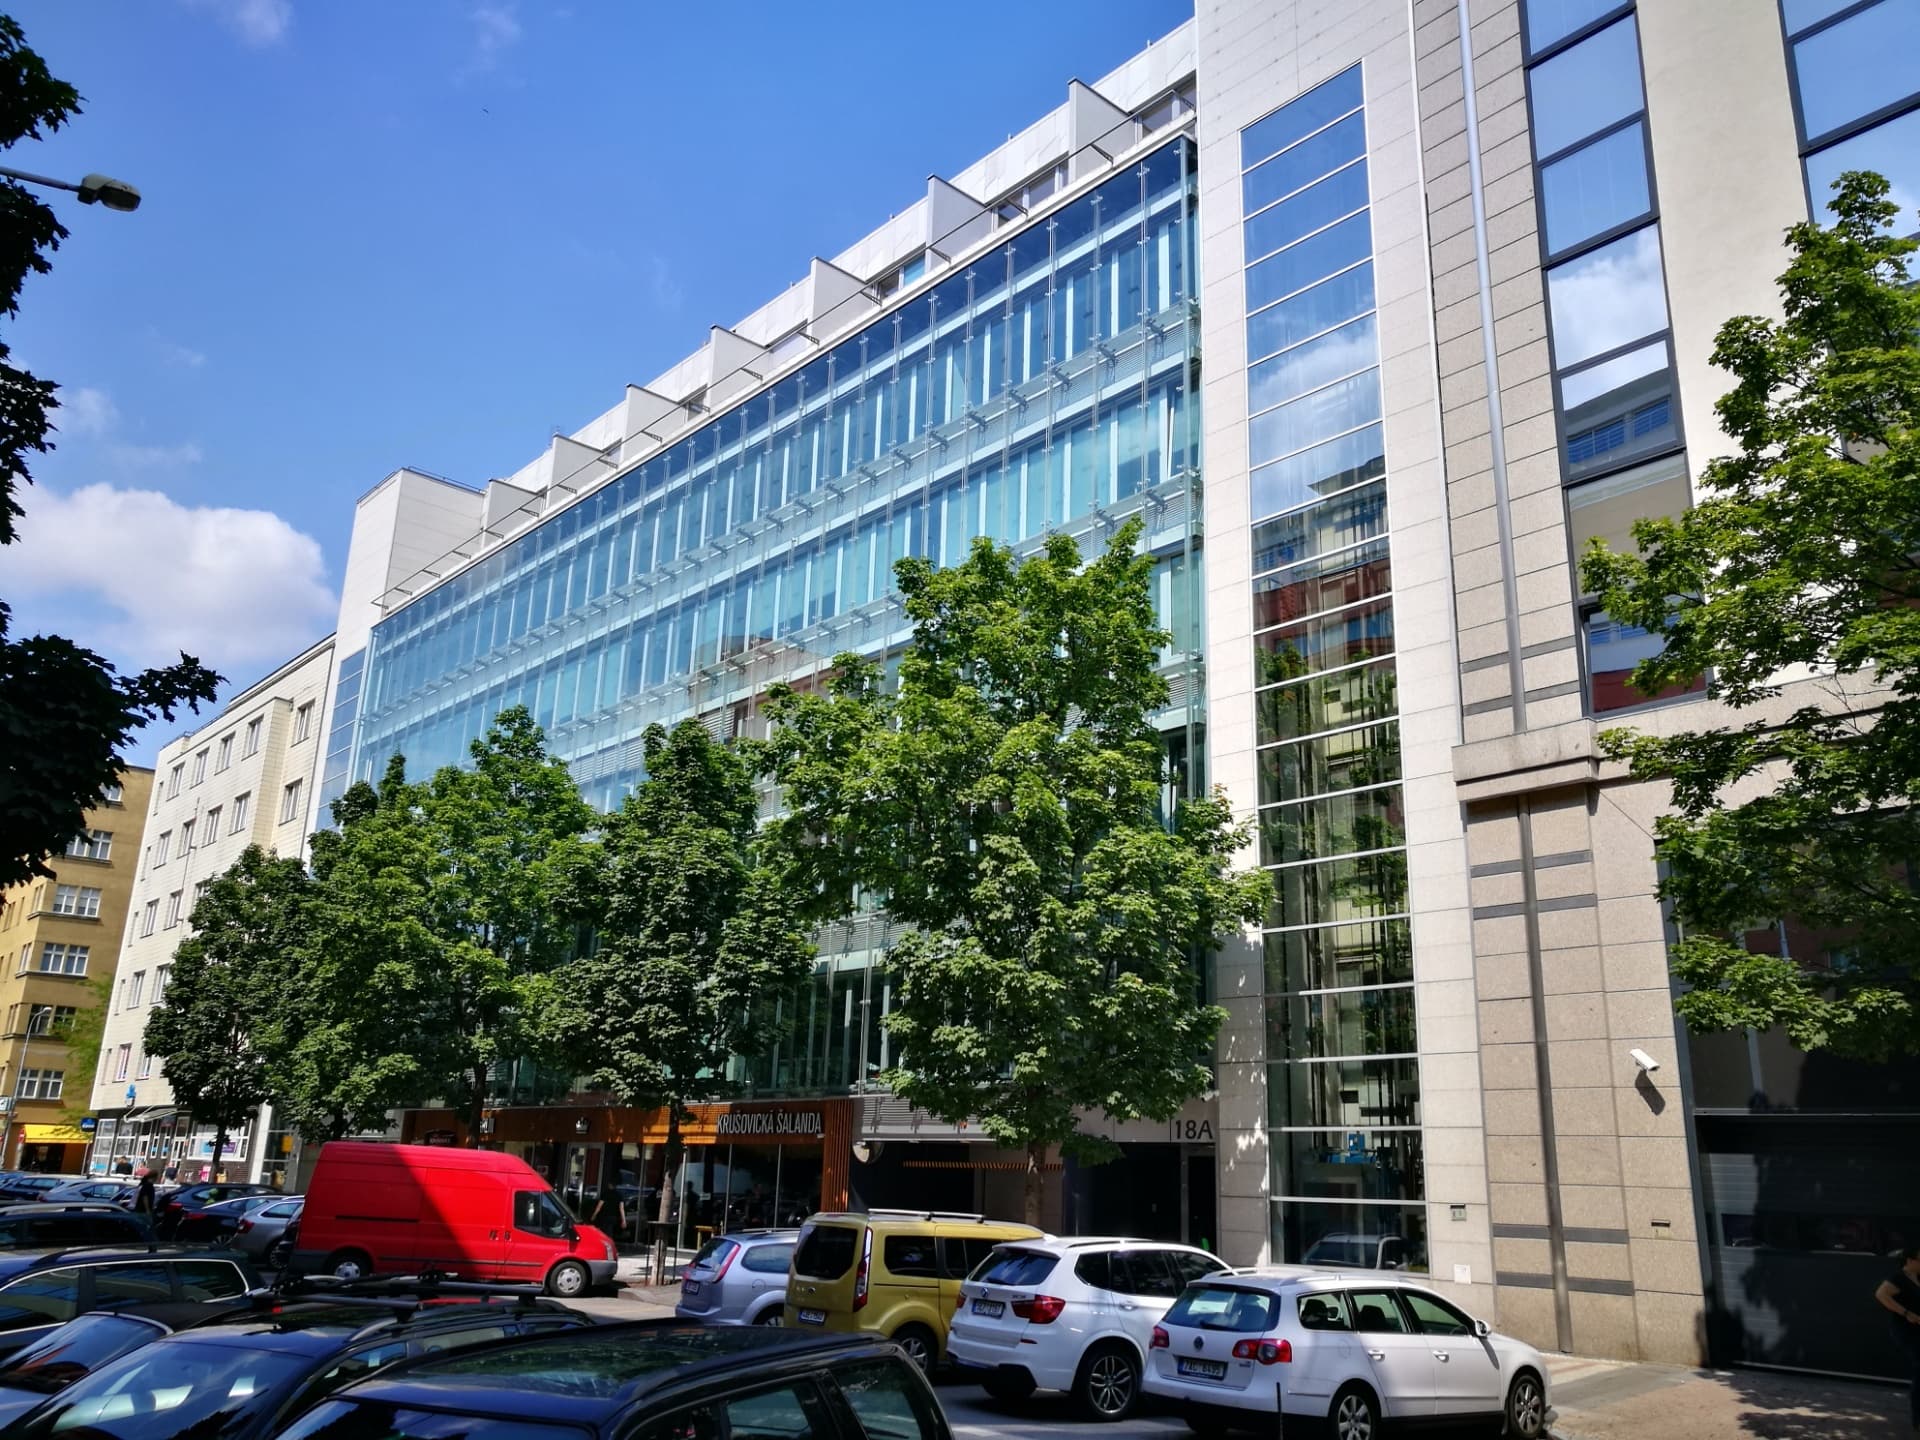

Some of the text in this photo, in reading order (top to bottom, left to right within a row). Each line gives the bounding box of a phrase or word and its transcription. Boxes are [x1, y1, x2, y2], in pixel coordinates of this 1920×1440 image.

[717, 1108, 821, 1134] KRUŠOVICKÁ ŠALANDA
[1175, 1119, 1213, 1139] 18A
